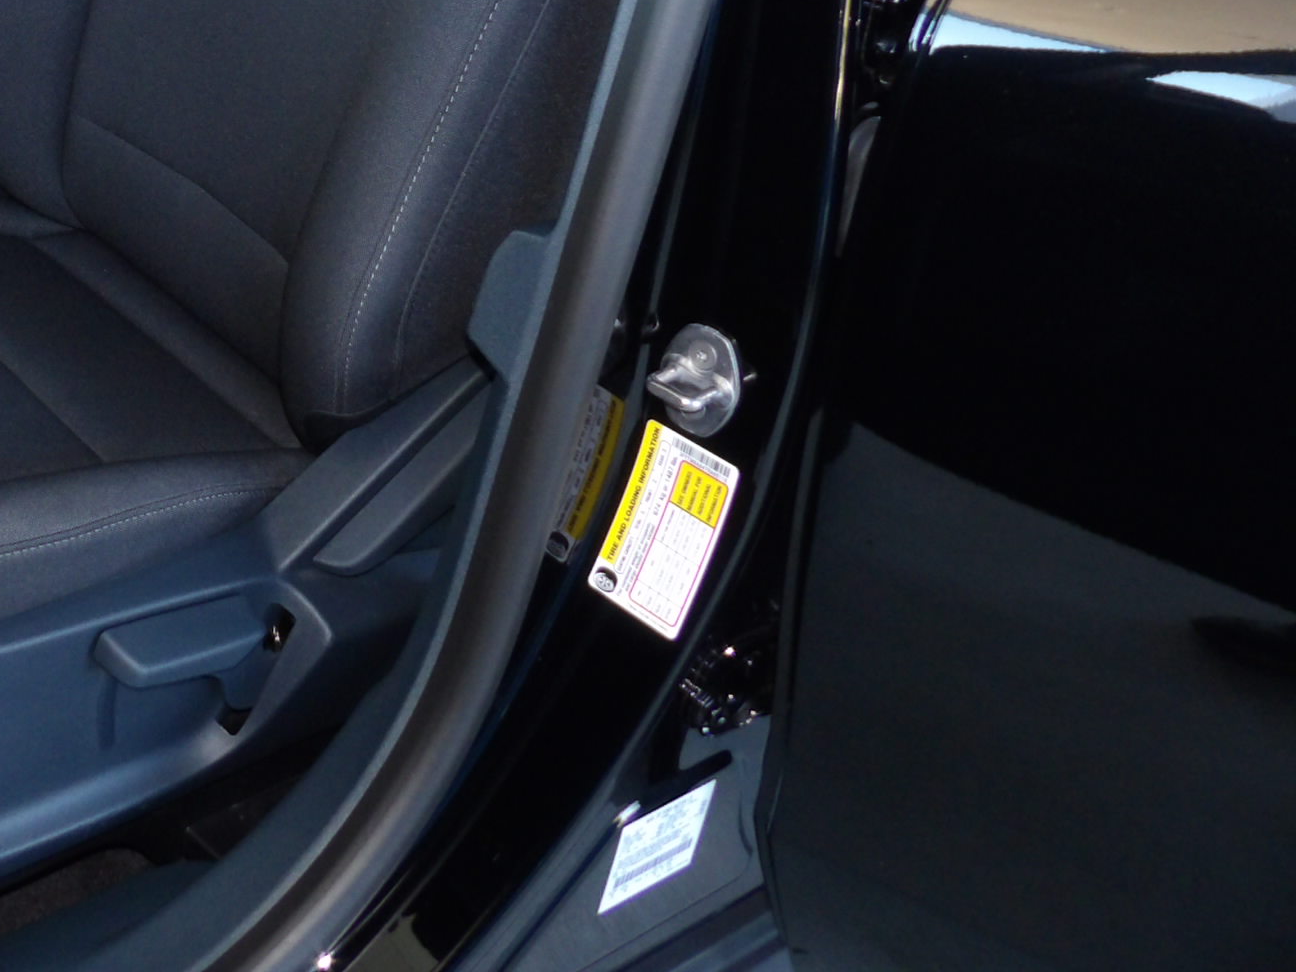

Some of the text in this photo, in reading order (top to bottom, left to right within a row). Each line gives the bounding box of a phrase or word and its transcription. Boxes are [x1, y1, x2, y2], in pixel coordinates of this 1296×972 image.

[607, 543, 618, 559] TIRE
[617, 523, 626, 540] AND
[624, 486, 641, 521] LOADING
[639, 427, 660, 483] INFORMATION
